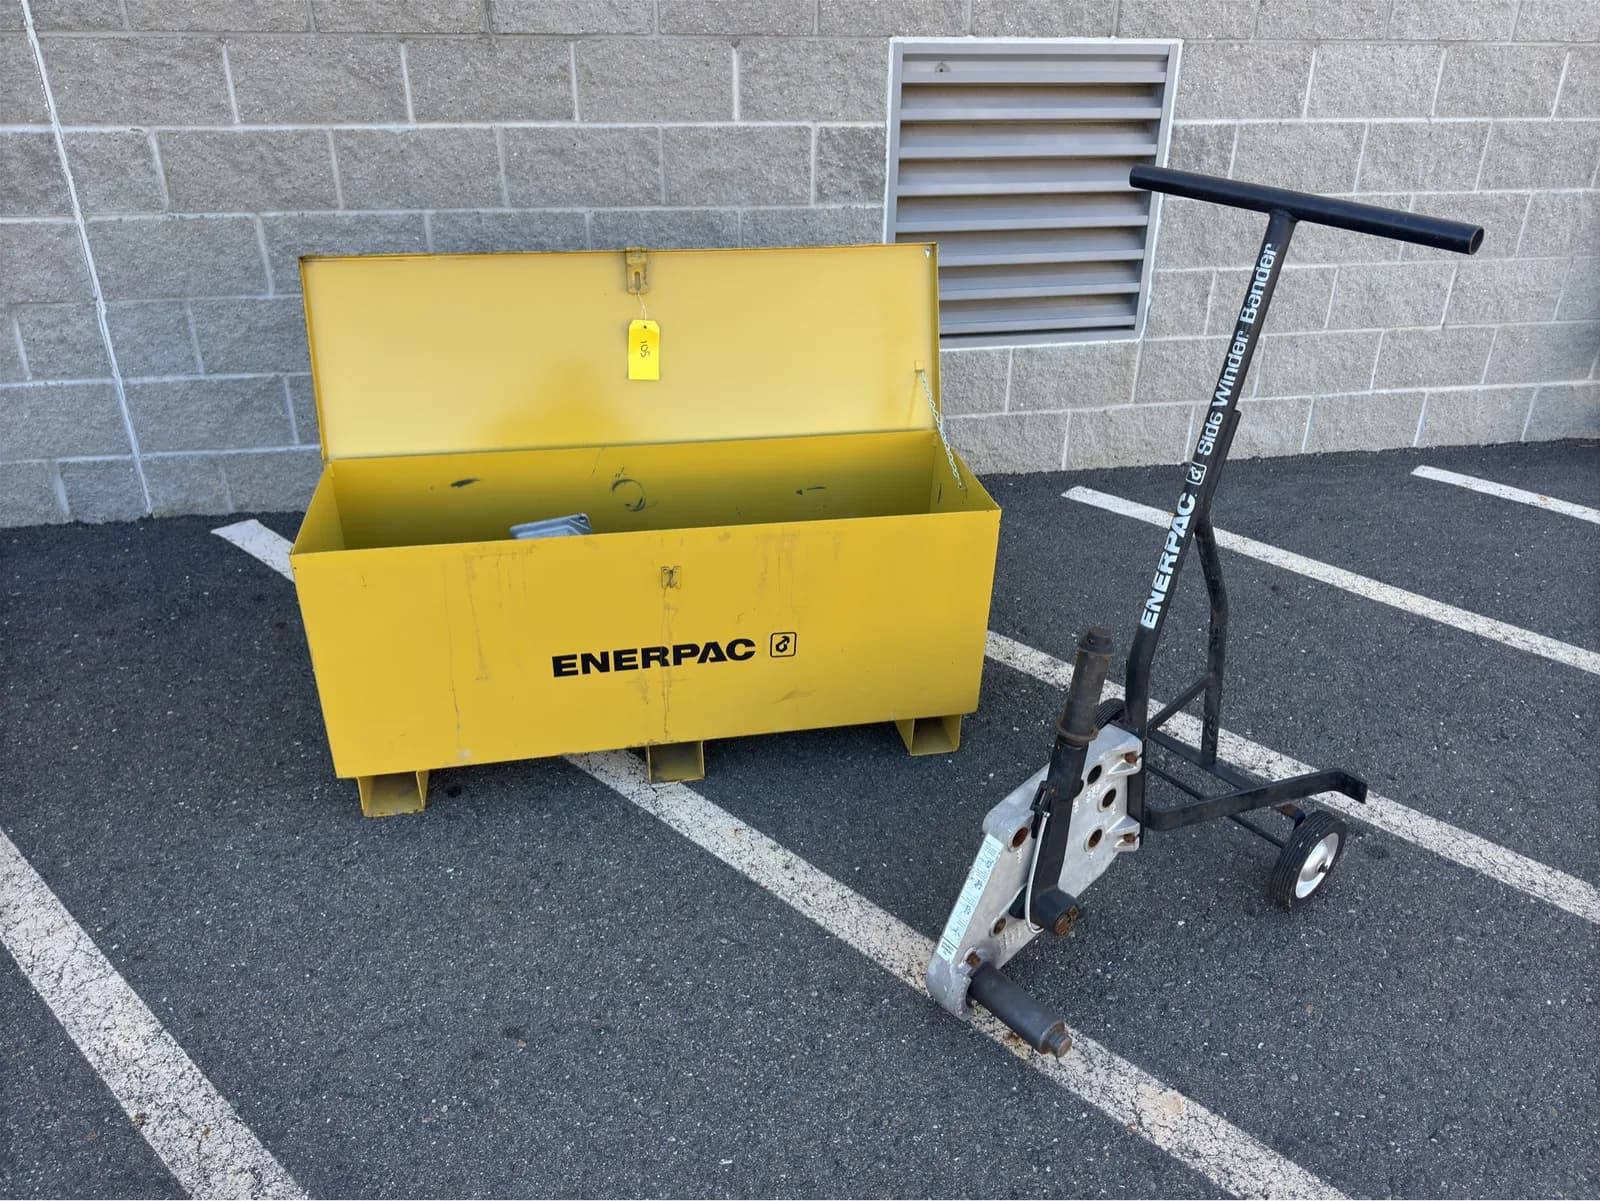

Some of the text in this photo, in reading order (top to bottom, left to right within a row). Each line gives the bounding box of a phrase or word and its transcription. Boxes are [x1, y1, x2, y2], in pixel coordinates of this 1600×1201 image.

[1140, 243, 1277, 630] ENERPAC Side Winder Bender
[552, 638, 756, 678] ENERPAC
